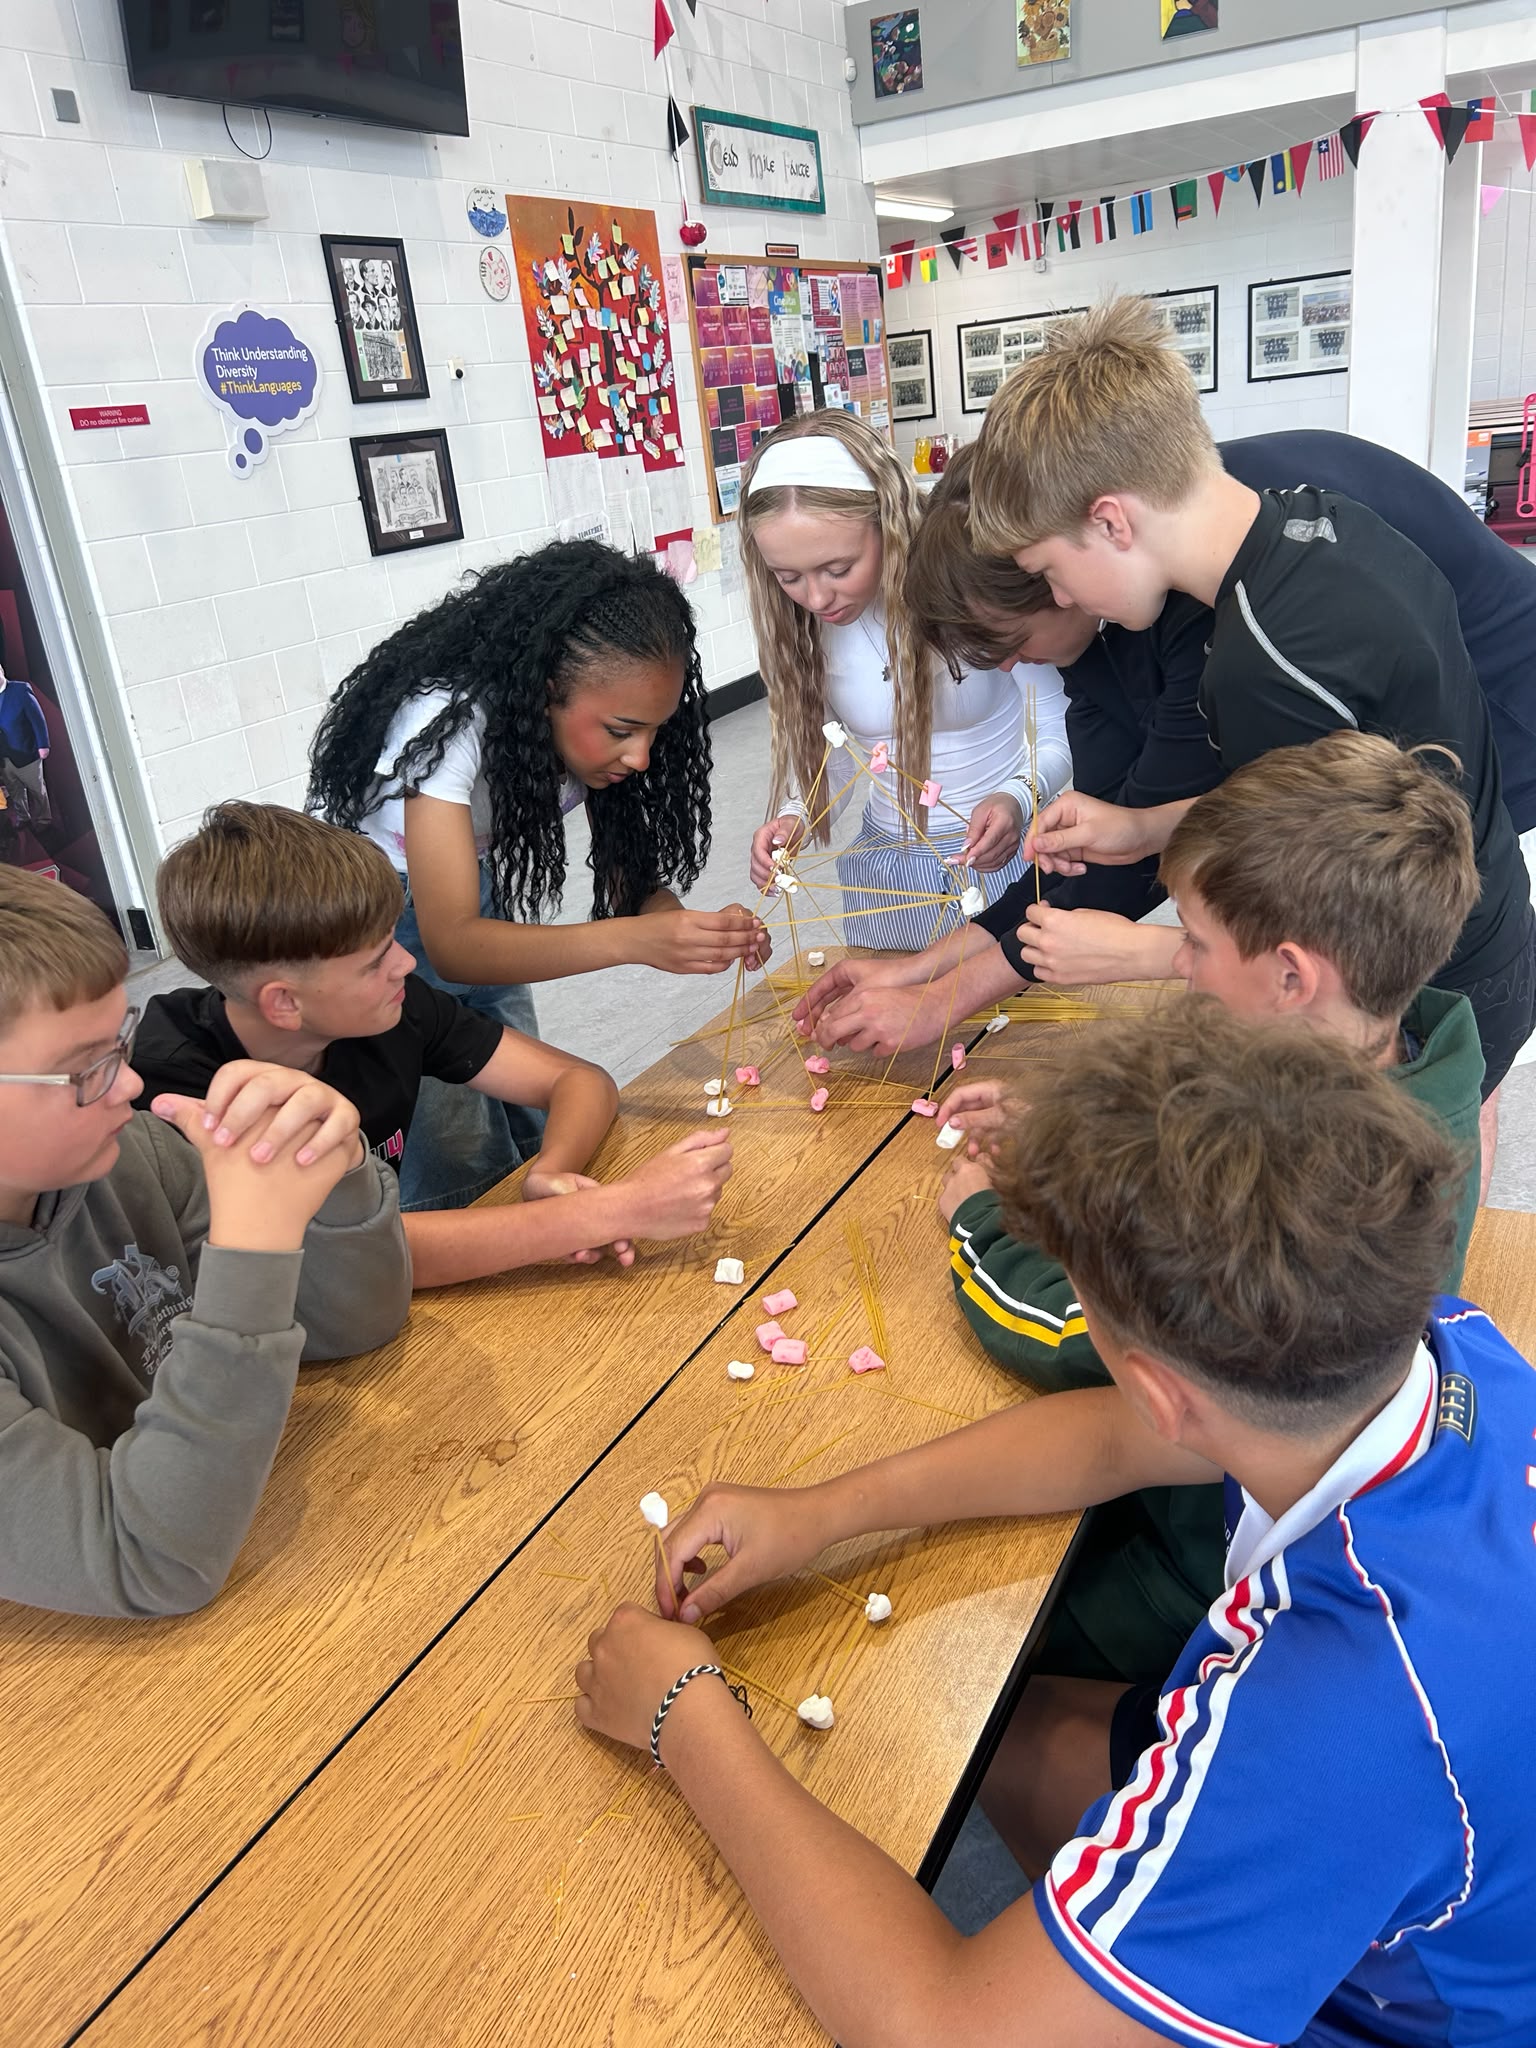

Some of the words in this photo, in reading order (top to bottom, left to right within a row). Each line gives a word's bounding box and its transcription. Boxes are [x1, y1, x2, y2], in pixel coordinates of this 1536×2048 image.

[211, 347, 241, 362] Think
[241, 346, 309, 362] Understanding
[216, 364, 258, 380] Diversity
[221, 380, 302, 395] #ThinkLanguages
[98, 409, 122, 417] WARNING
[80, 419, 90, 427] DO
[98, 418, 118, 426] obstruct
[127, 416, 145, 424] curtain
